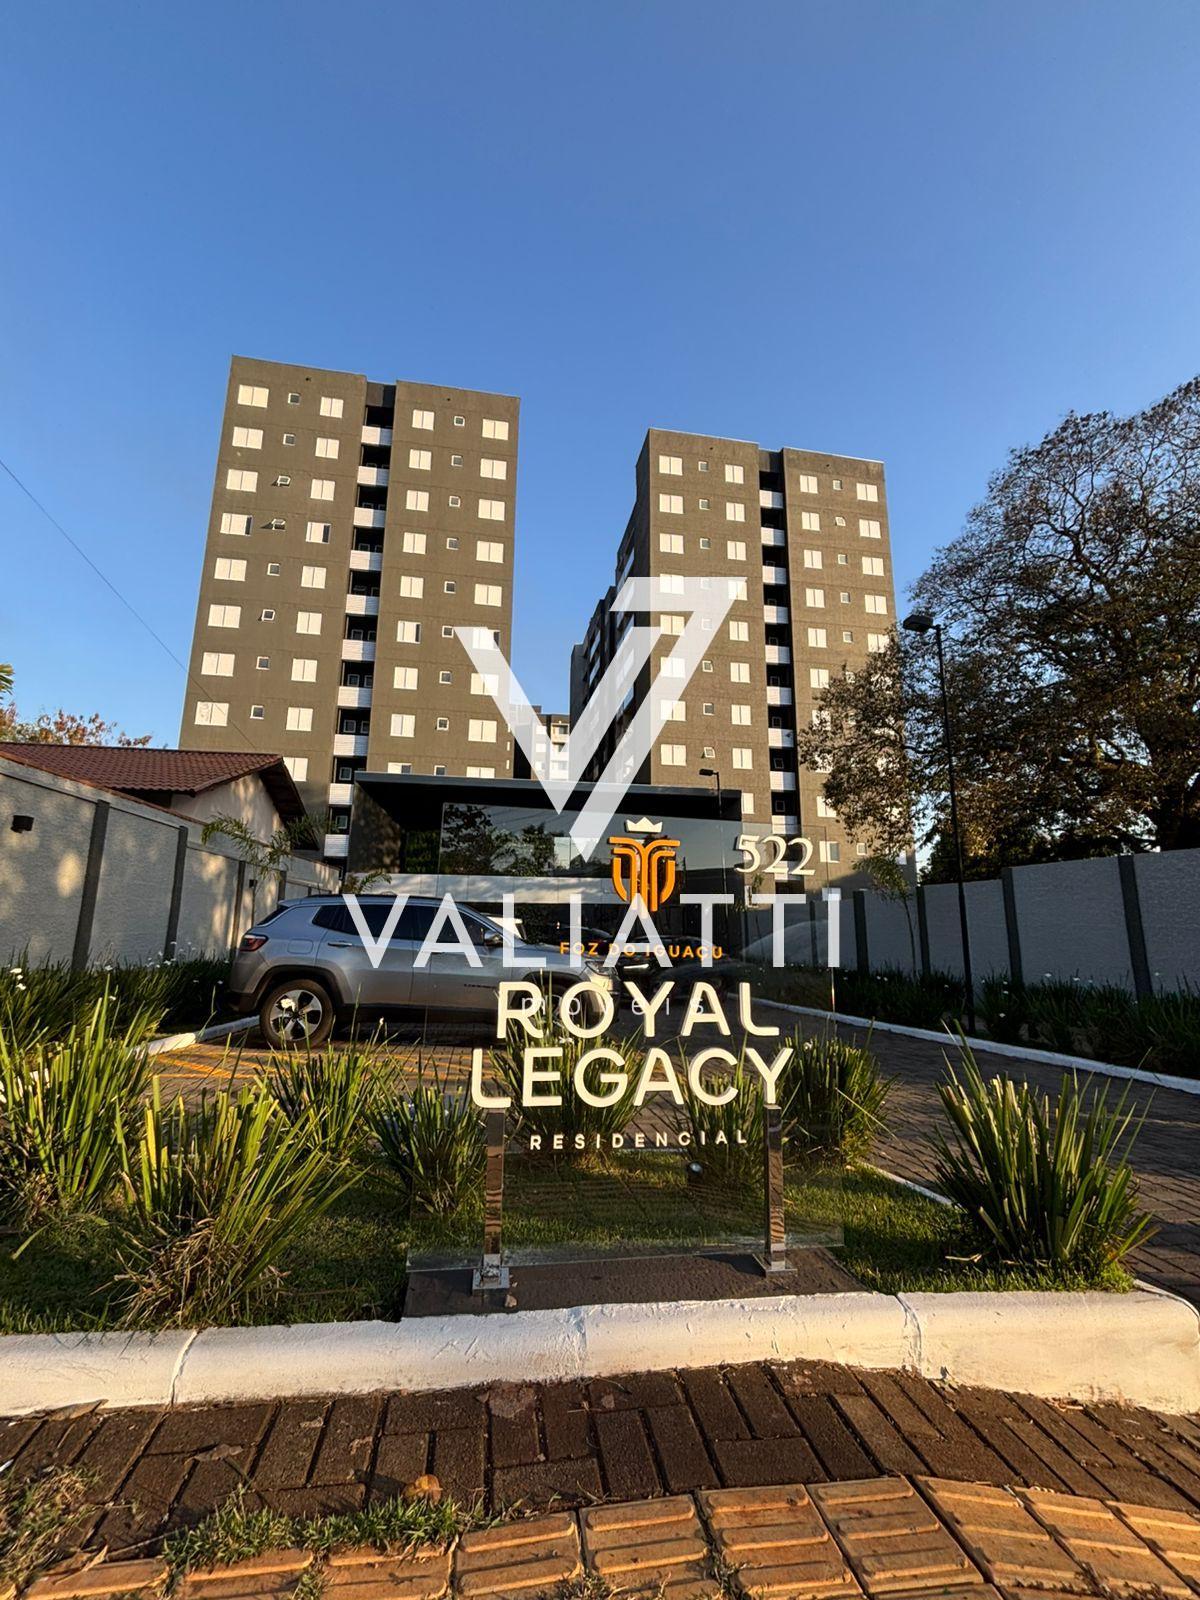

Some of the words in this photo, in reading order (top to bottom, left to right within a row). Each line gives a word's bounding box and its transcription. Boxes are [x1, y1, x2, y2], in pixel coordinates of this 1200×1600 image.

[734, 834, 816, 876] 522
[560, 942, 599, 956] FOZ
[608, 943, 636, 957] DO
[497, 981, 780, 1039] ROYAL
[471, 1047, 794, 1108] LEGACY
[529, 1130, 748, 1151] RESIDENCIAL
